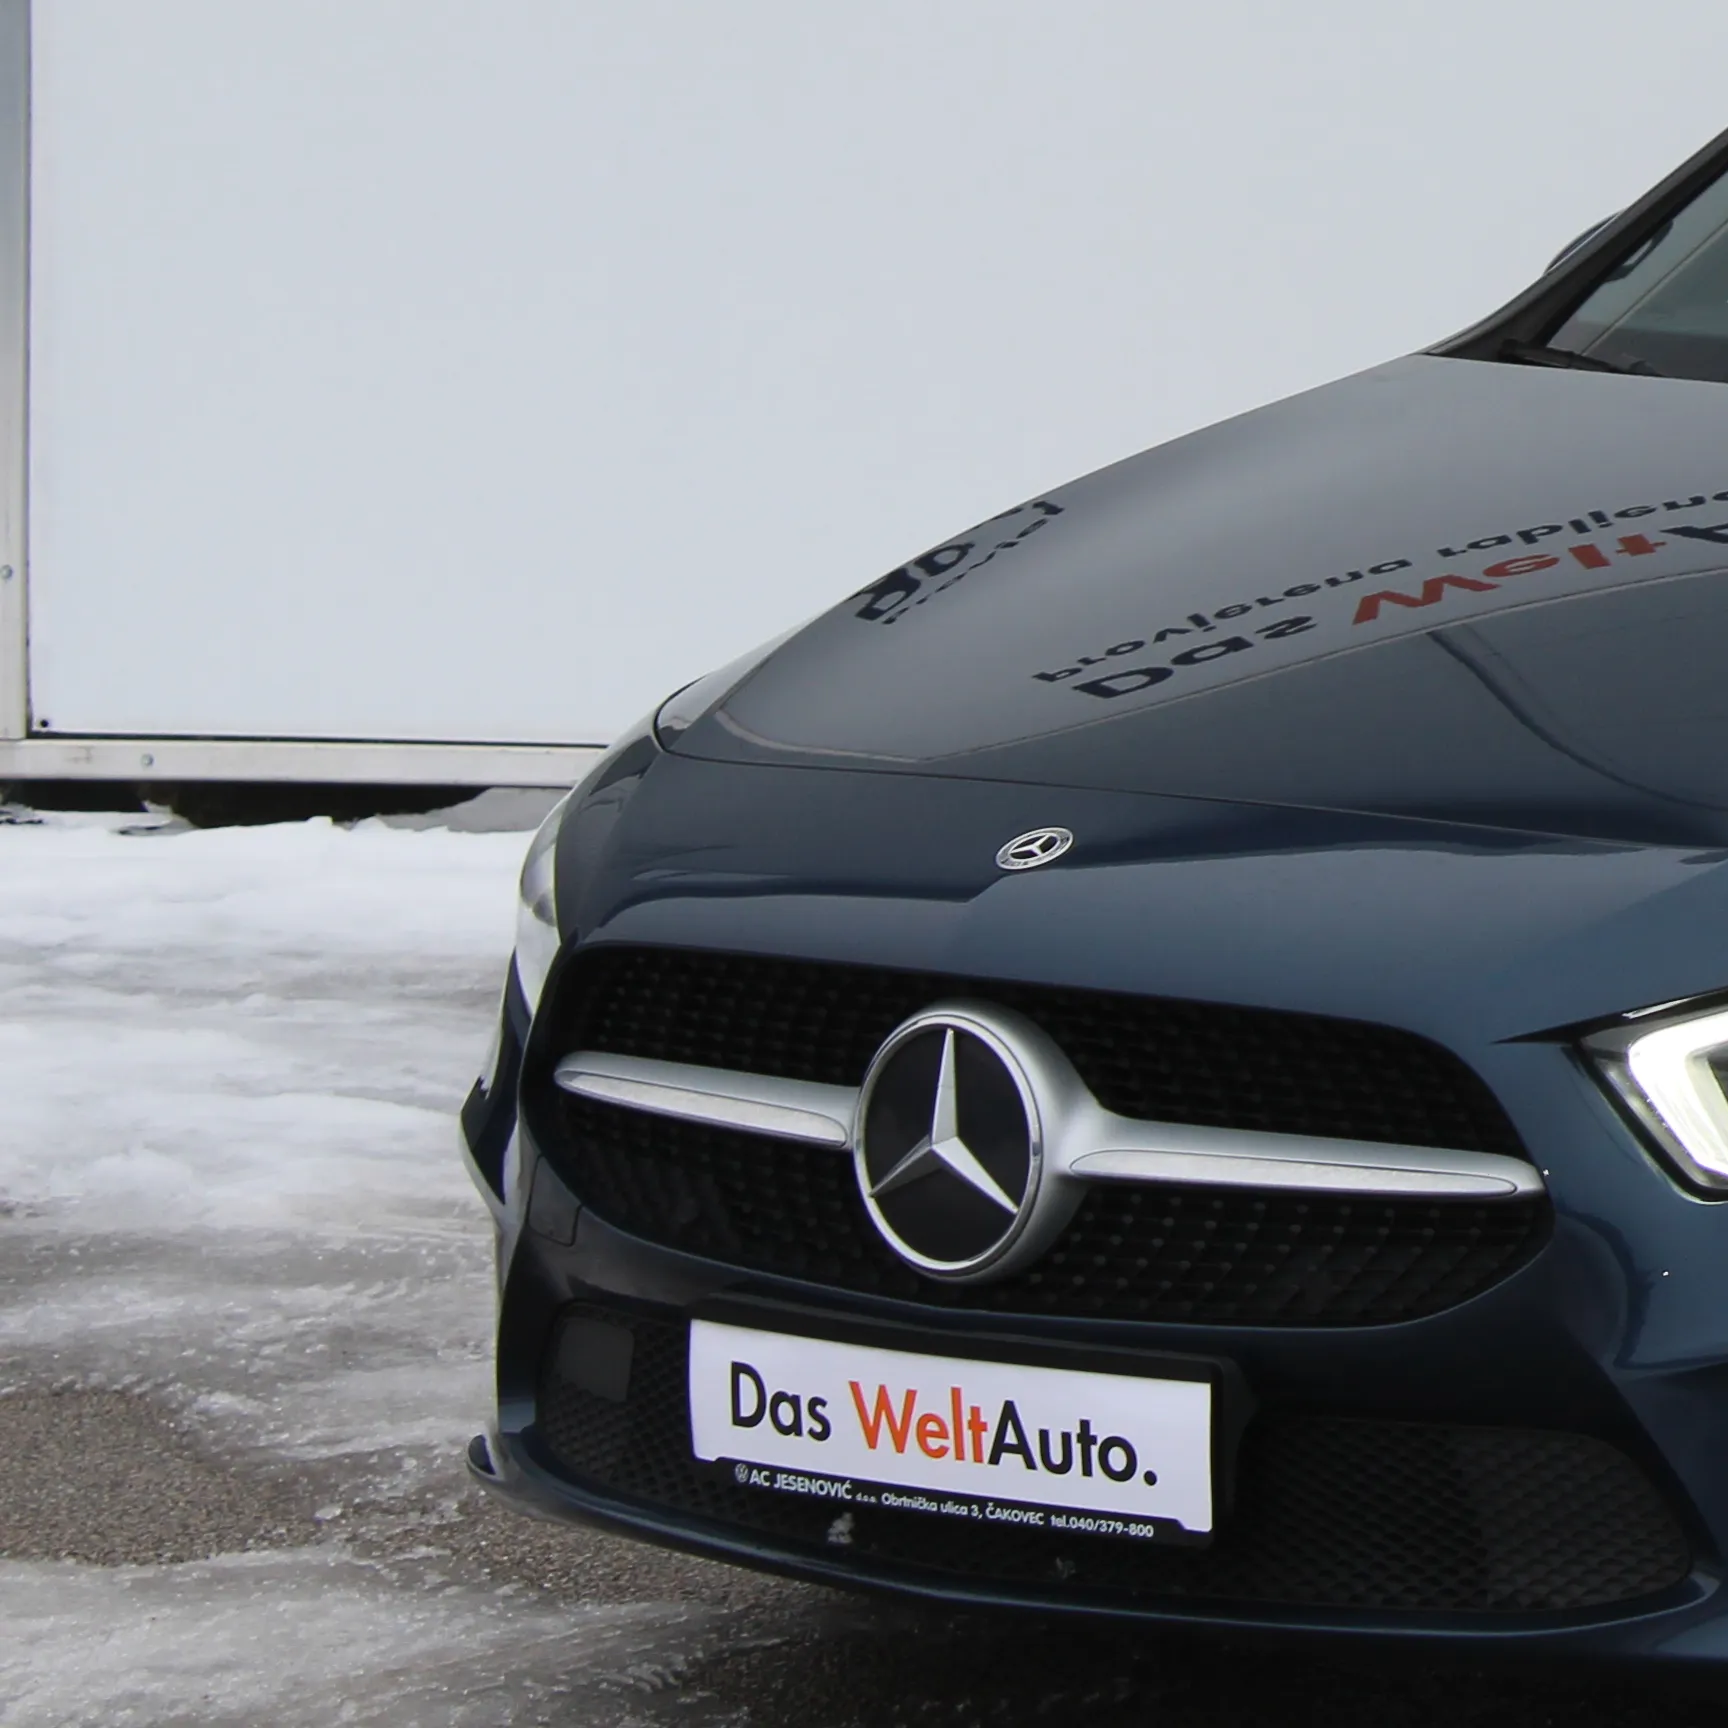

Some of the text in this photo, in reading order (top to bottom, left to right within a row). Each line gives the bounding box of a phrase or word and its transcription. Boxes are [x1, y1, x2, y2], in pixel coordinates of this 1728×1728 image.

[730, 1361, 1158, 1487] Das WeltAuto.
[749, 1469, 771, 1487] AC
[773, 1473, 852, 1500] JESENOVIĆ
[881, 1492, 938, 1513] Obrtnička
[940, 1501, 969, 1516] ulica
[970, 1504, 983, 1520] 3,
[985, 1502, 1044, 1525] ČAKOVEC
